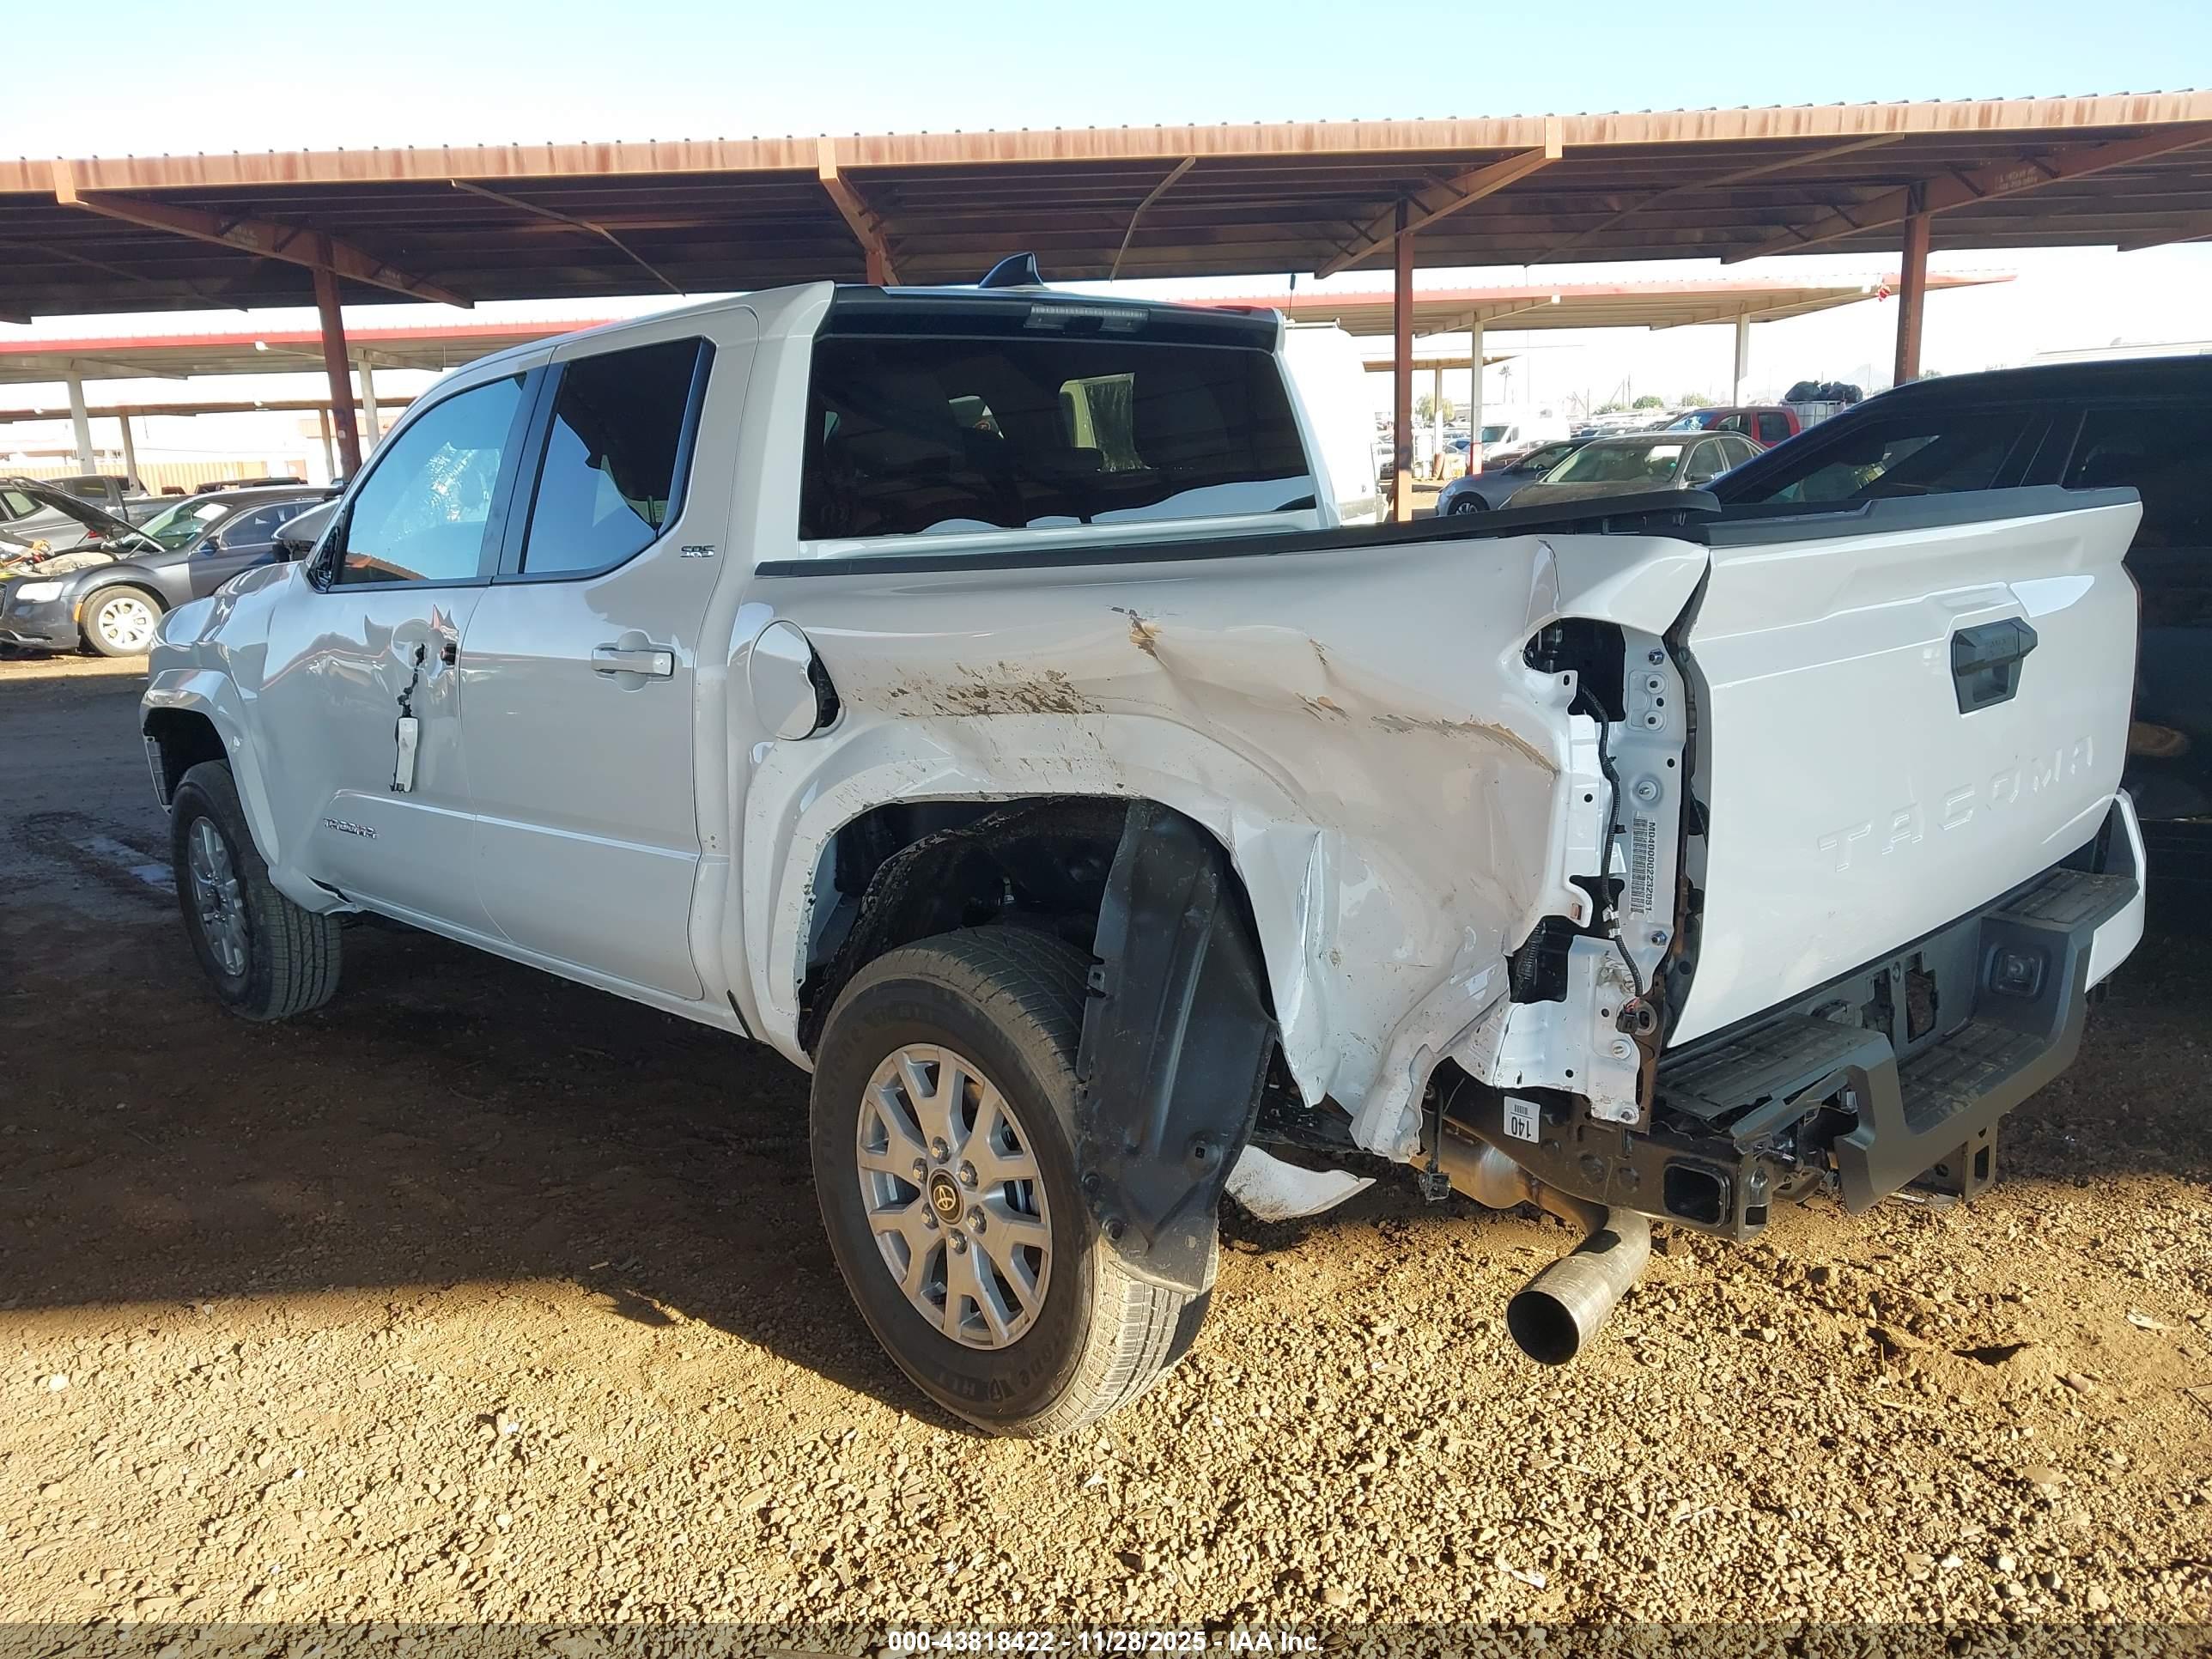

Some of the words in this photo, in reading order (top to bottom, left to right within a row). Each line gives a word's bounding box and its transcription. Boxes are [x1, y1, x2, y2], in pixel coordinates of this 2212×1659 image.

[680, 544, 715, 558] SR5
[1817, 735, 2094, 873] TACOMA
[323, 817, 376, 839] TACOMA
[1511, 1116, 1532, 1139] 140
